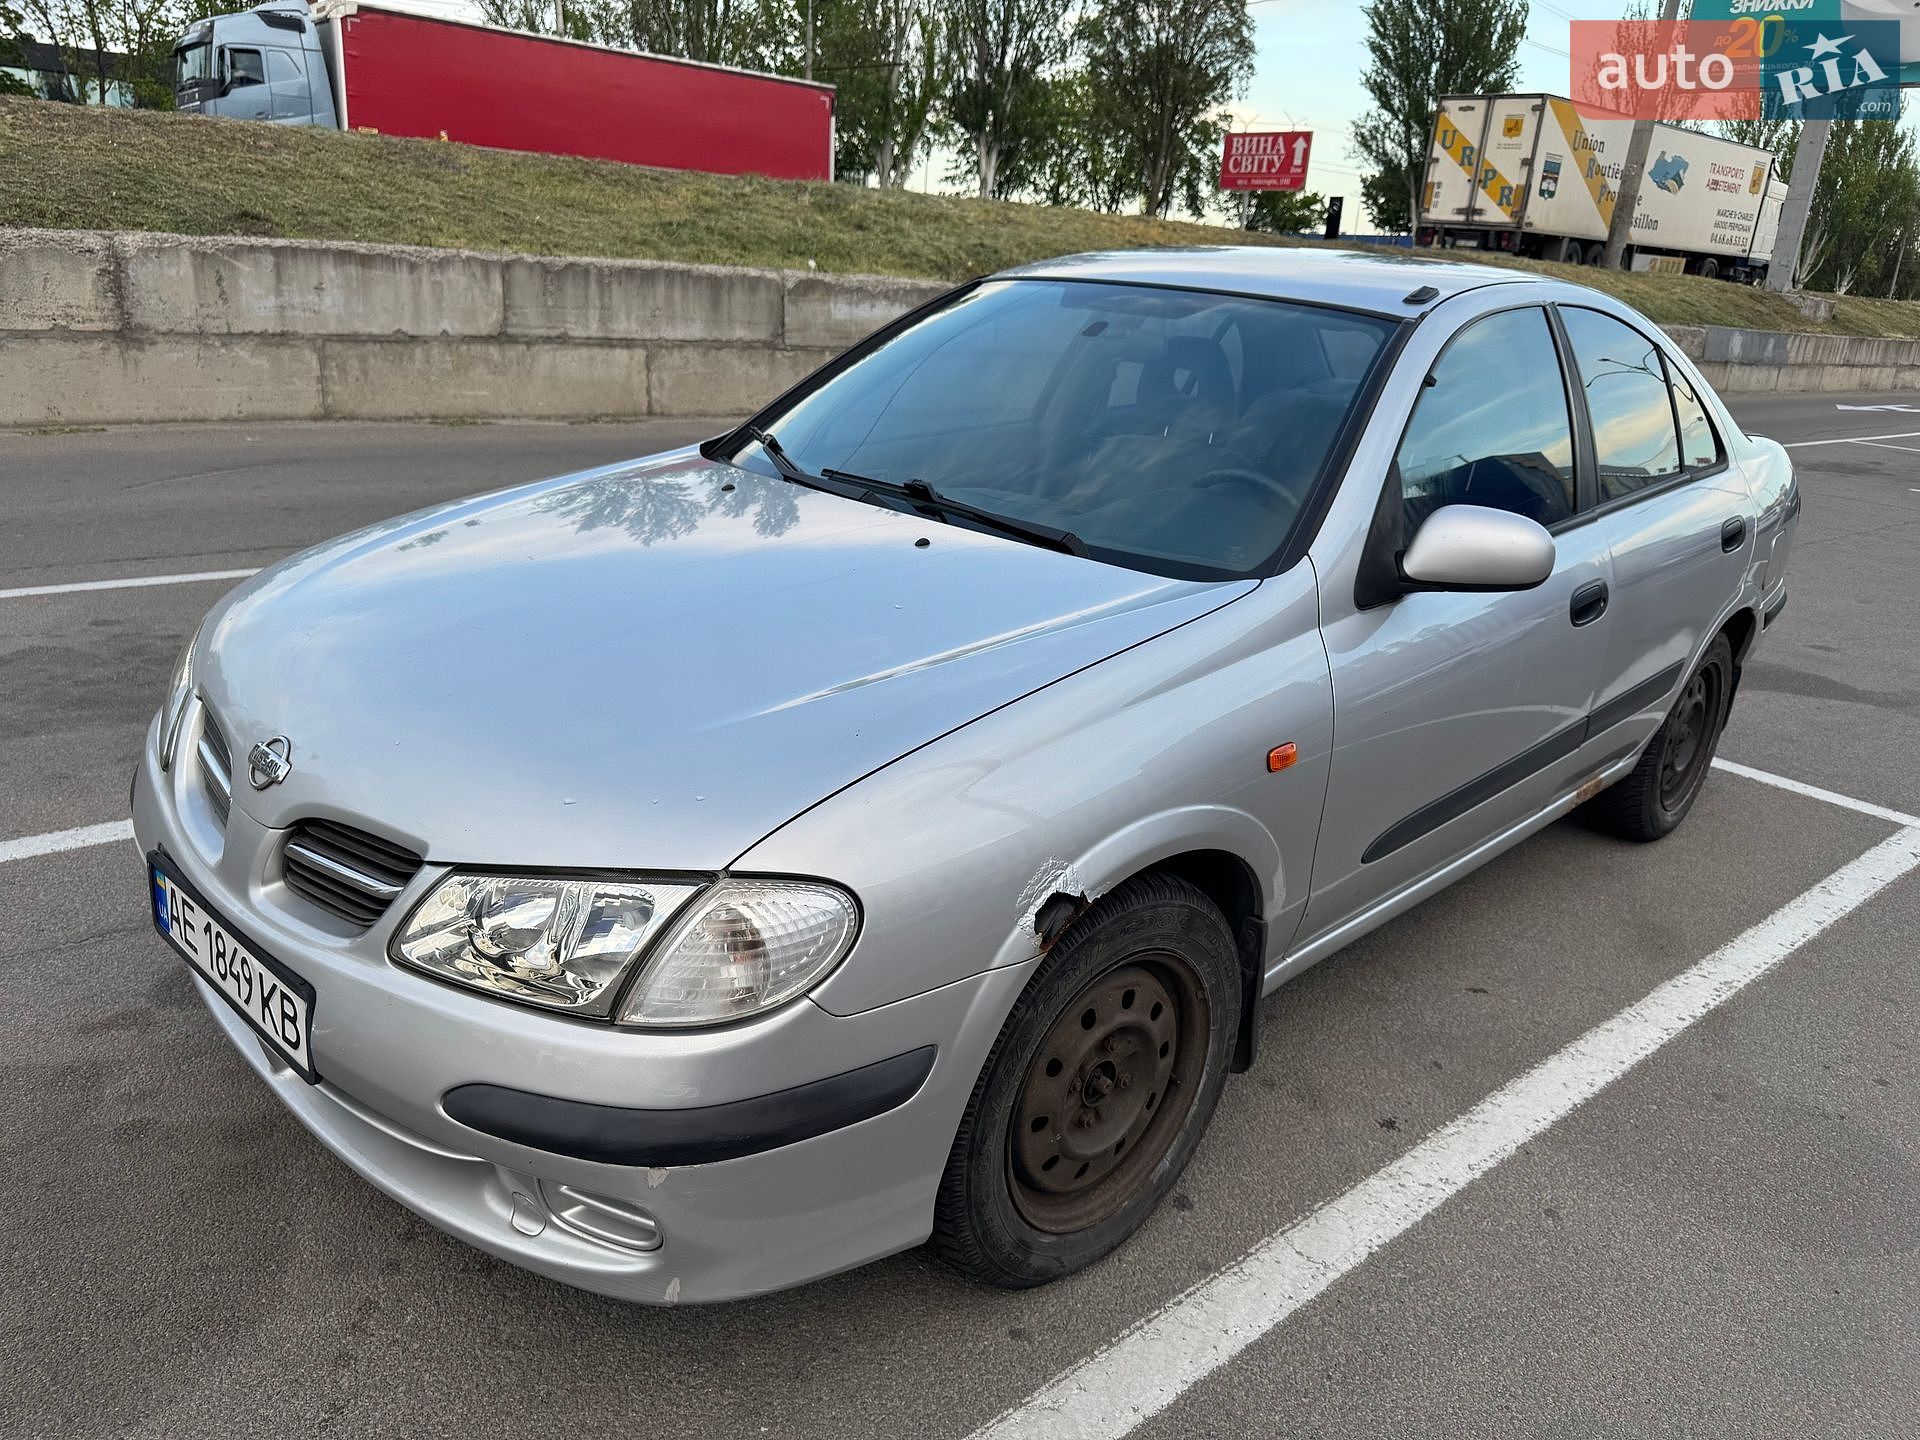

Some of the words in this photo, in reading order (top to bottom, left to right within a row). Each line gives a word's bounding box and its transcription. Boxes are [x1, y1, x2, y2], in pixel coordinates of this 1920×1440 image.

[1231, 136, 1286, 154] ВИНА
[1573, 130, 1605, 153] Union
[1228, 154, 1285, 173] СВІТУ
[1710, 162, 1745, 180] TRANSPORTS
[158, 903, 169, 923] UA
[169, 886, 199, 956] AE
[203, 920, 253, 1006] 1849
[259, 971, 301, 1051] KB
